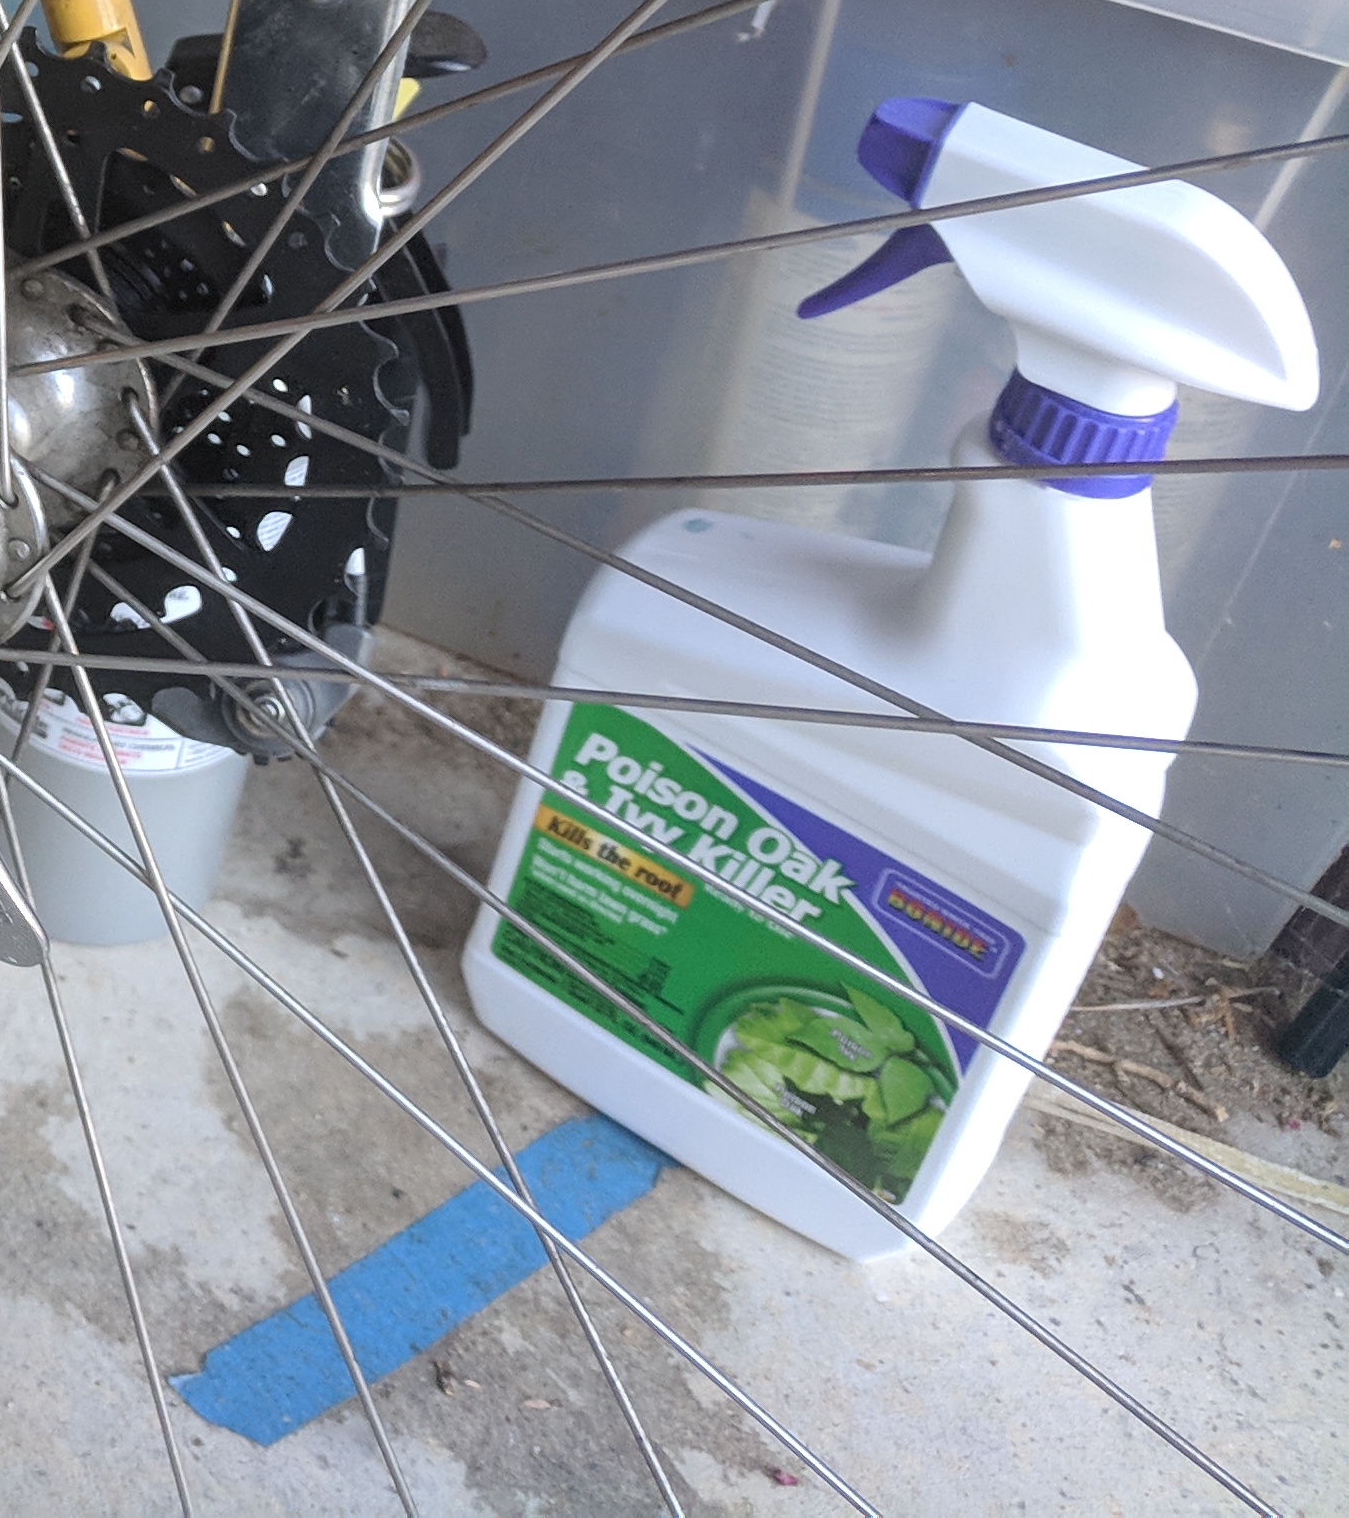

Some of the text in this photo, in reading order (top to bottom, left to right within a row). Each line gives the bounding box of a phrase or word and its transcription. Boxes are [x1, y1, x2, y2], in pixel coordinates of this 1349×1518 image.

[548, 816, 592, 850] Kills
[597, 842, 631, 870] the
[633, 867, 683, 900] root
[574, 732, 856, 904] Poison Oak
[603, 786, 685, 853] Ivy
[686, 835, 822, 924] Killer
